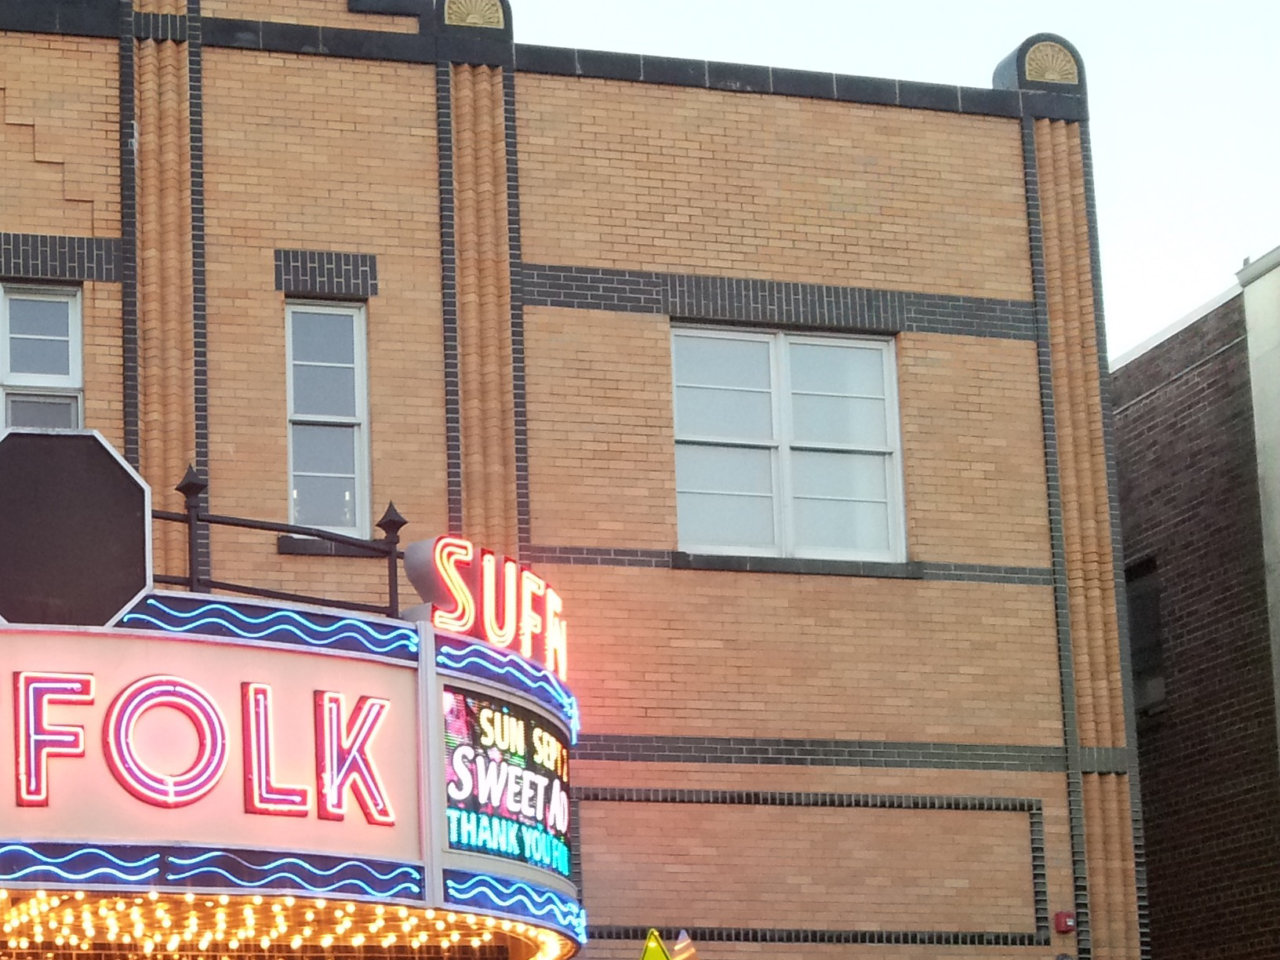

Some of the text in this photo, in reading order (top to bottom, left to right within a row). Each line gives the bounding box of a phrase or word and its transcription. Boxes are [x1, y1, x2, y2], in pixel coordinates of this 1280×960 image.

[431, 535, 567, 682] SUFF
[479, 708, 526, 756] SUN
[447, 745, 549, 821] SWEET
[446, 808, 520, 855] THANK
[521, 825, 551, 865] YOU
